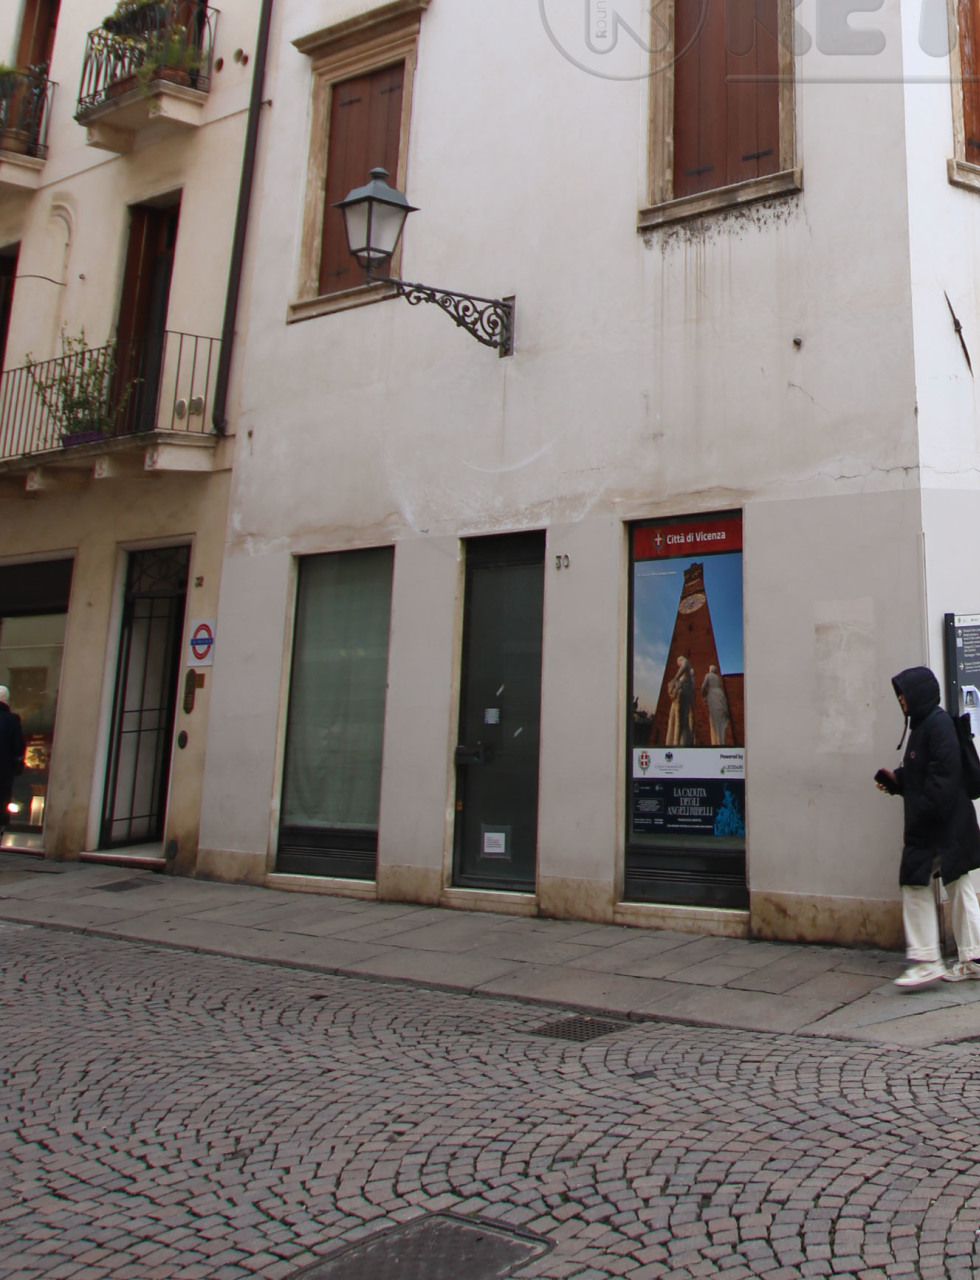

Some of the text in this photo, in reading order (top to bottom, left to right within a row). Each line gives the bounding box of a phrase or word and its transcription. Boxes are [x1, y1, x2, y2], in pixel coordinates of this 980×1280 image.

[666, 531, 726, 545] Città di Vicenza
[555, 554, 570, 571] 30
[673, 787, 707, 798] LA CADUTA
